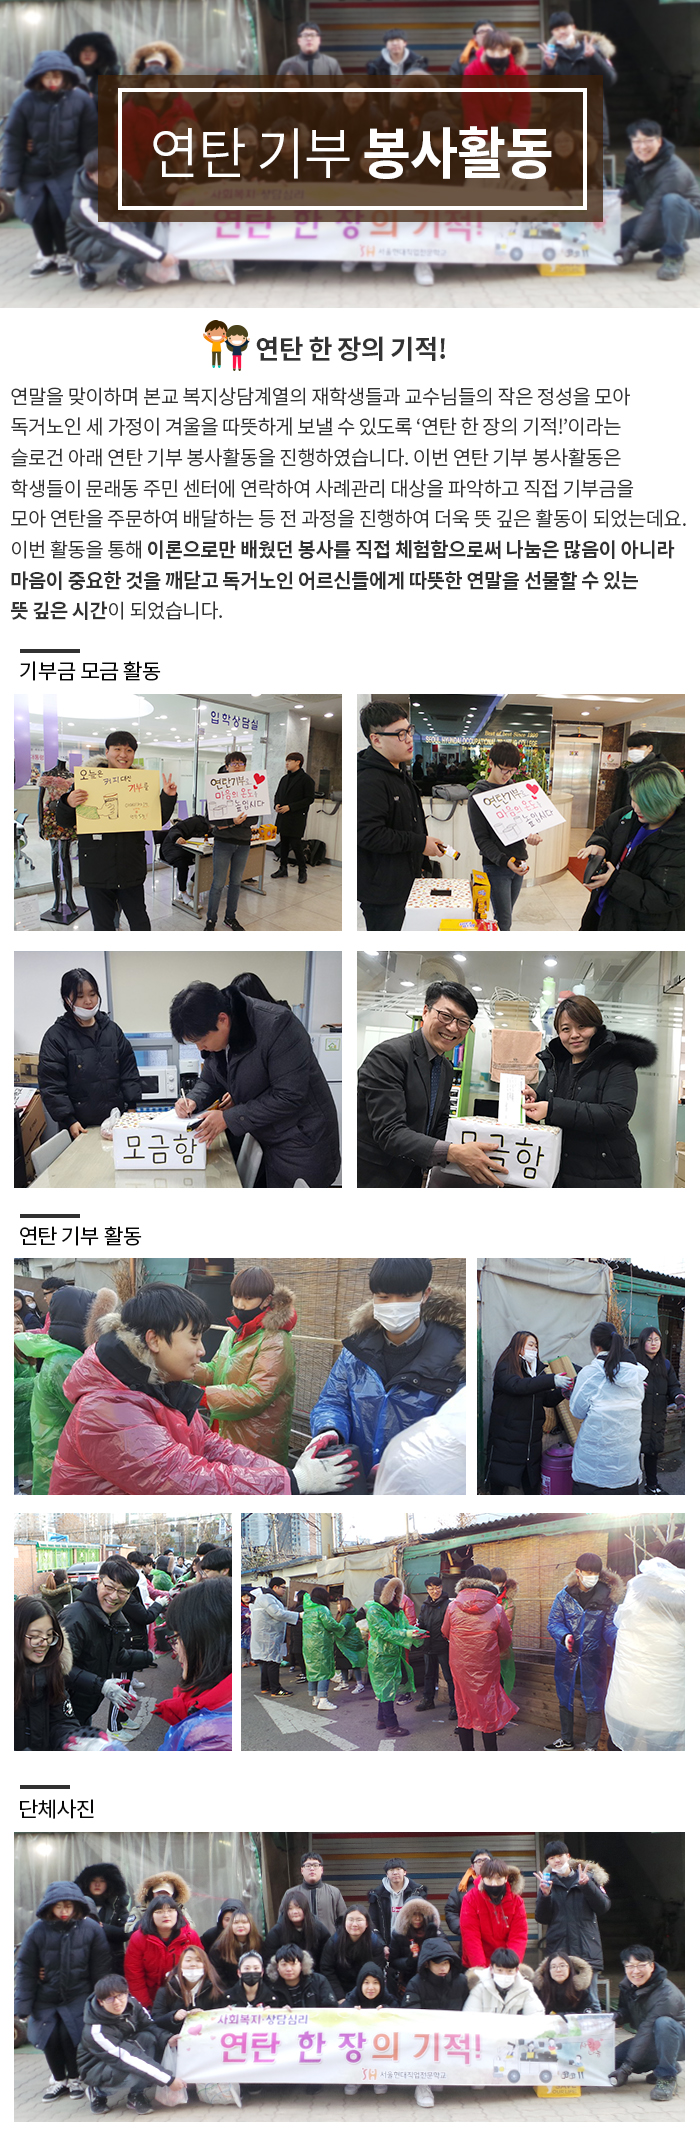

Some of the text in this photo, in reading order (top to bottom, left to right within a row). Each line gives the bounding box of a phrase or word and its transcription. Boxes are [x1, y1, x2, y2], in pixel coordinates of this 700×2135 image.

[210, 711, 259, 731] 입학상담실
[215, 789, 239, 800] 마음의
[495, 805, 522, 819] 마음의
[123, 1133, 197, 1164] 모금함
[220, 2030, 482, 2065] 연탄 한 장의 기적!
[380, 2071, 446, 2080] 서울현대직업전문학교
